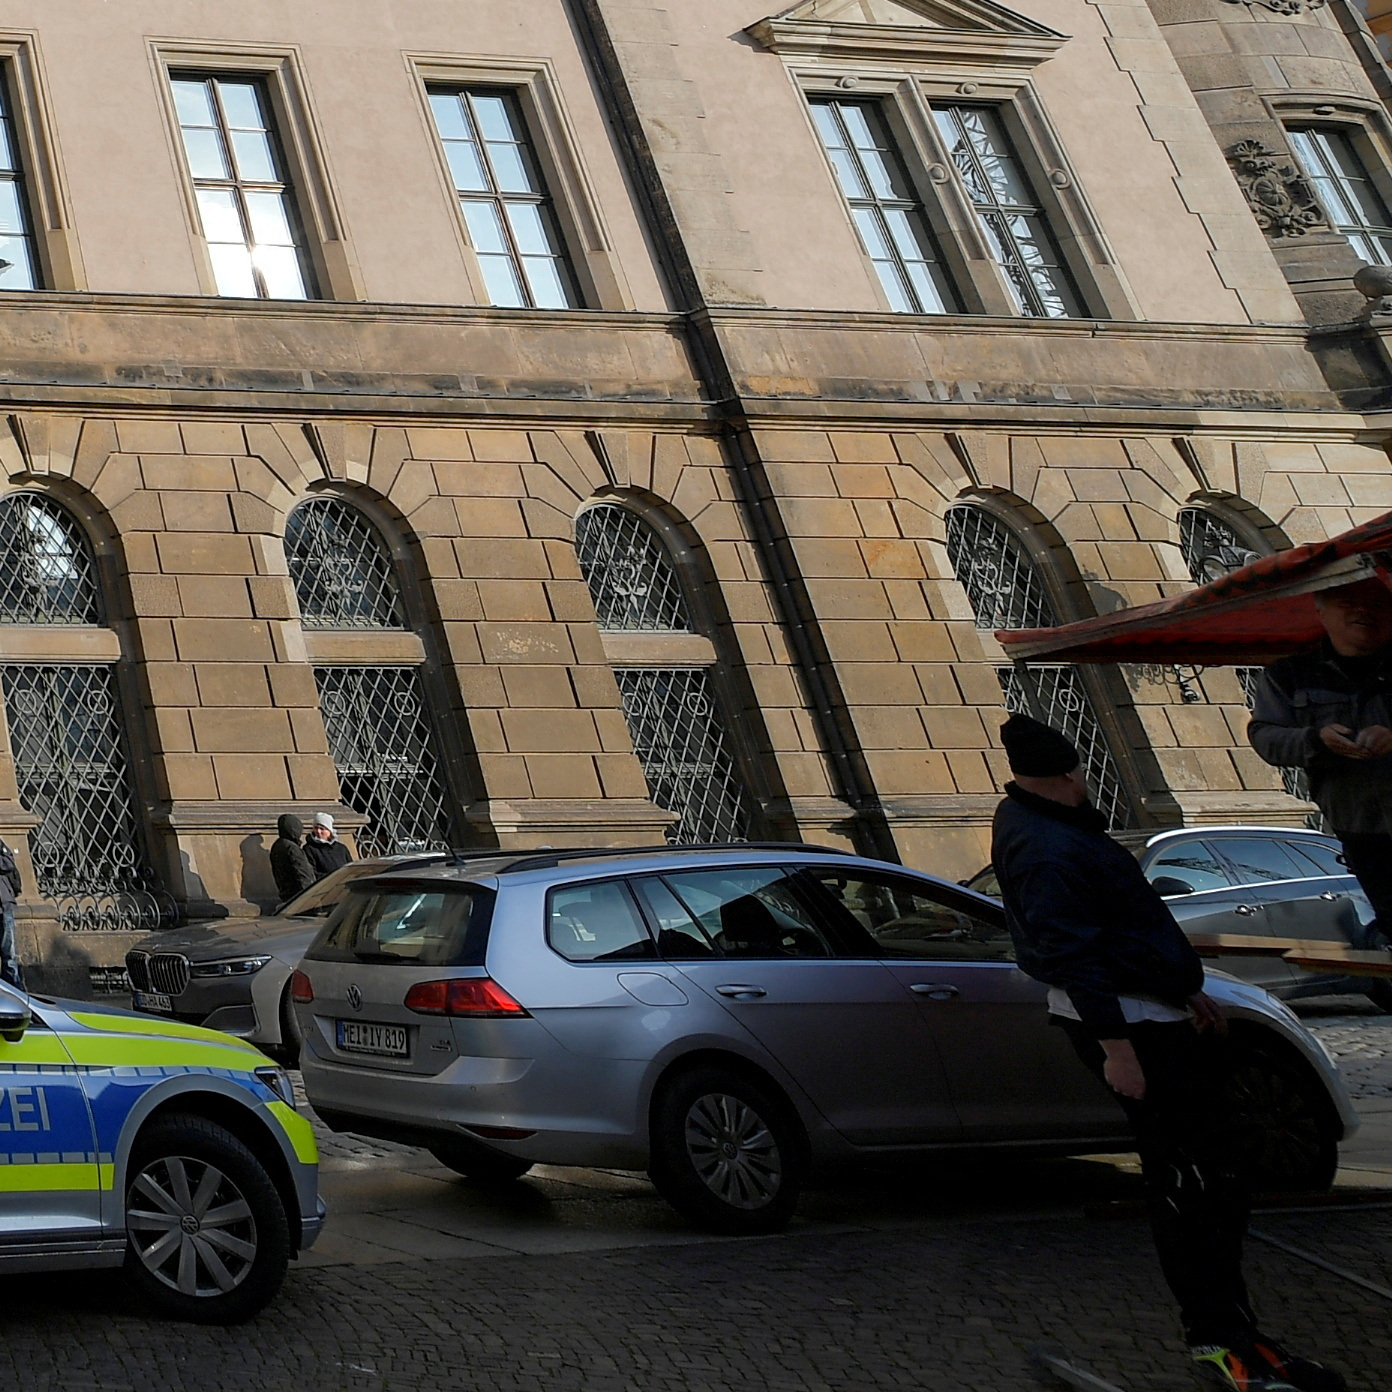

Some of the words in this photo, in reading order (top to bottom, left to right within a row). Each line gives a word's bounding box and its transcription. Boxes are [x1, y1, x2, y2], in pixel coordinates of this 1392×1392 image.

[343, 1024, 361, 1045] MEI
[370, 1026, 382, 1048] IY
[385, 1028, 405, 1050] 819
